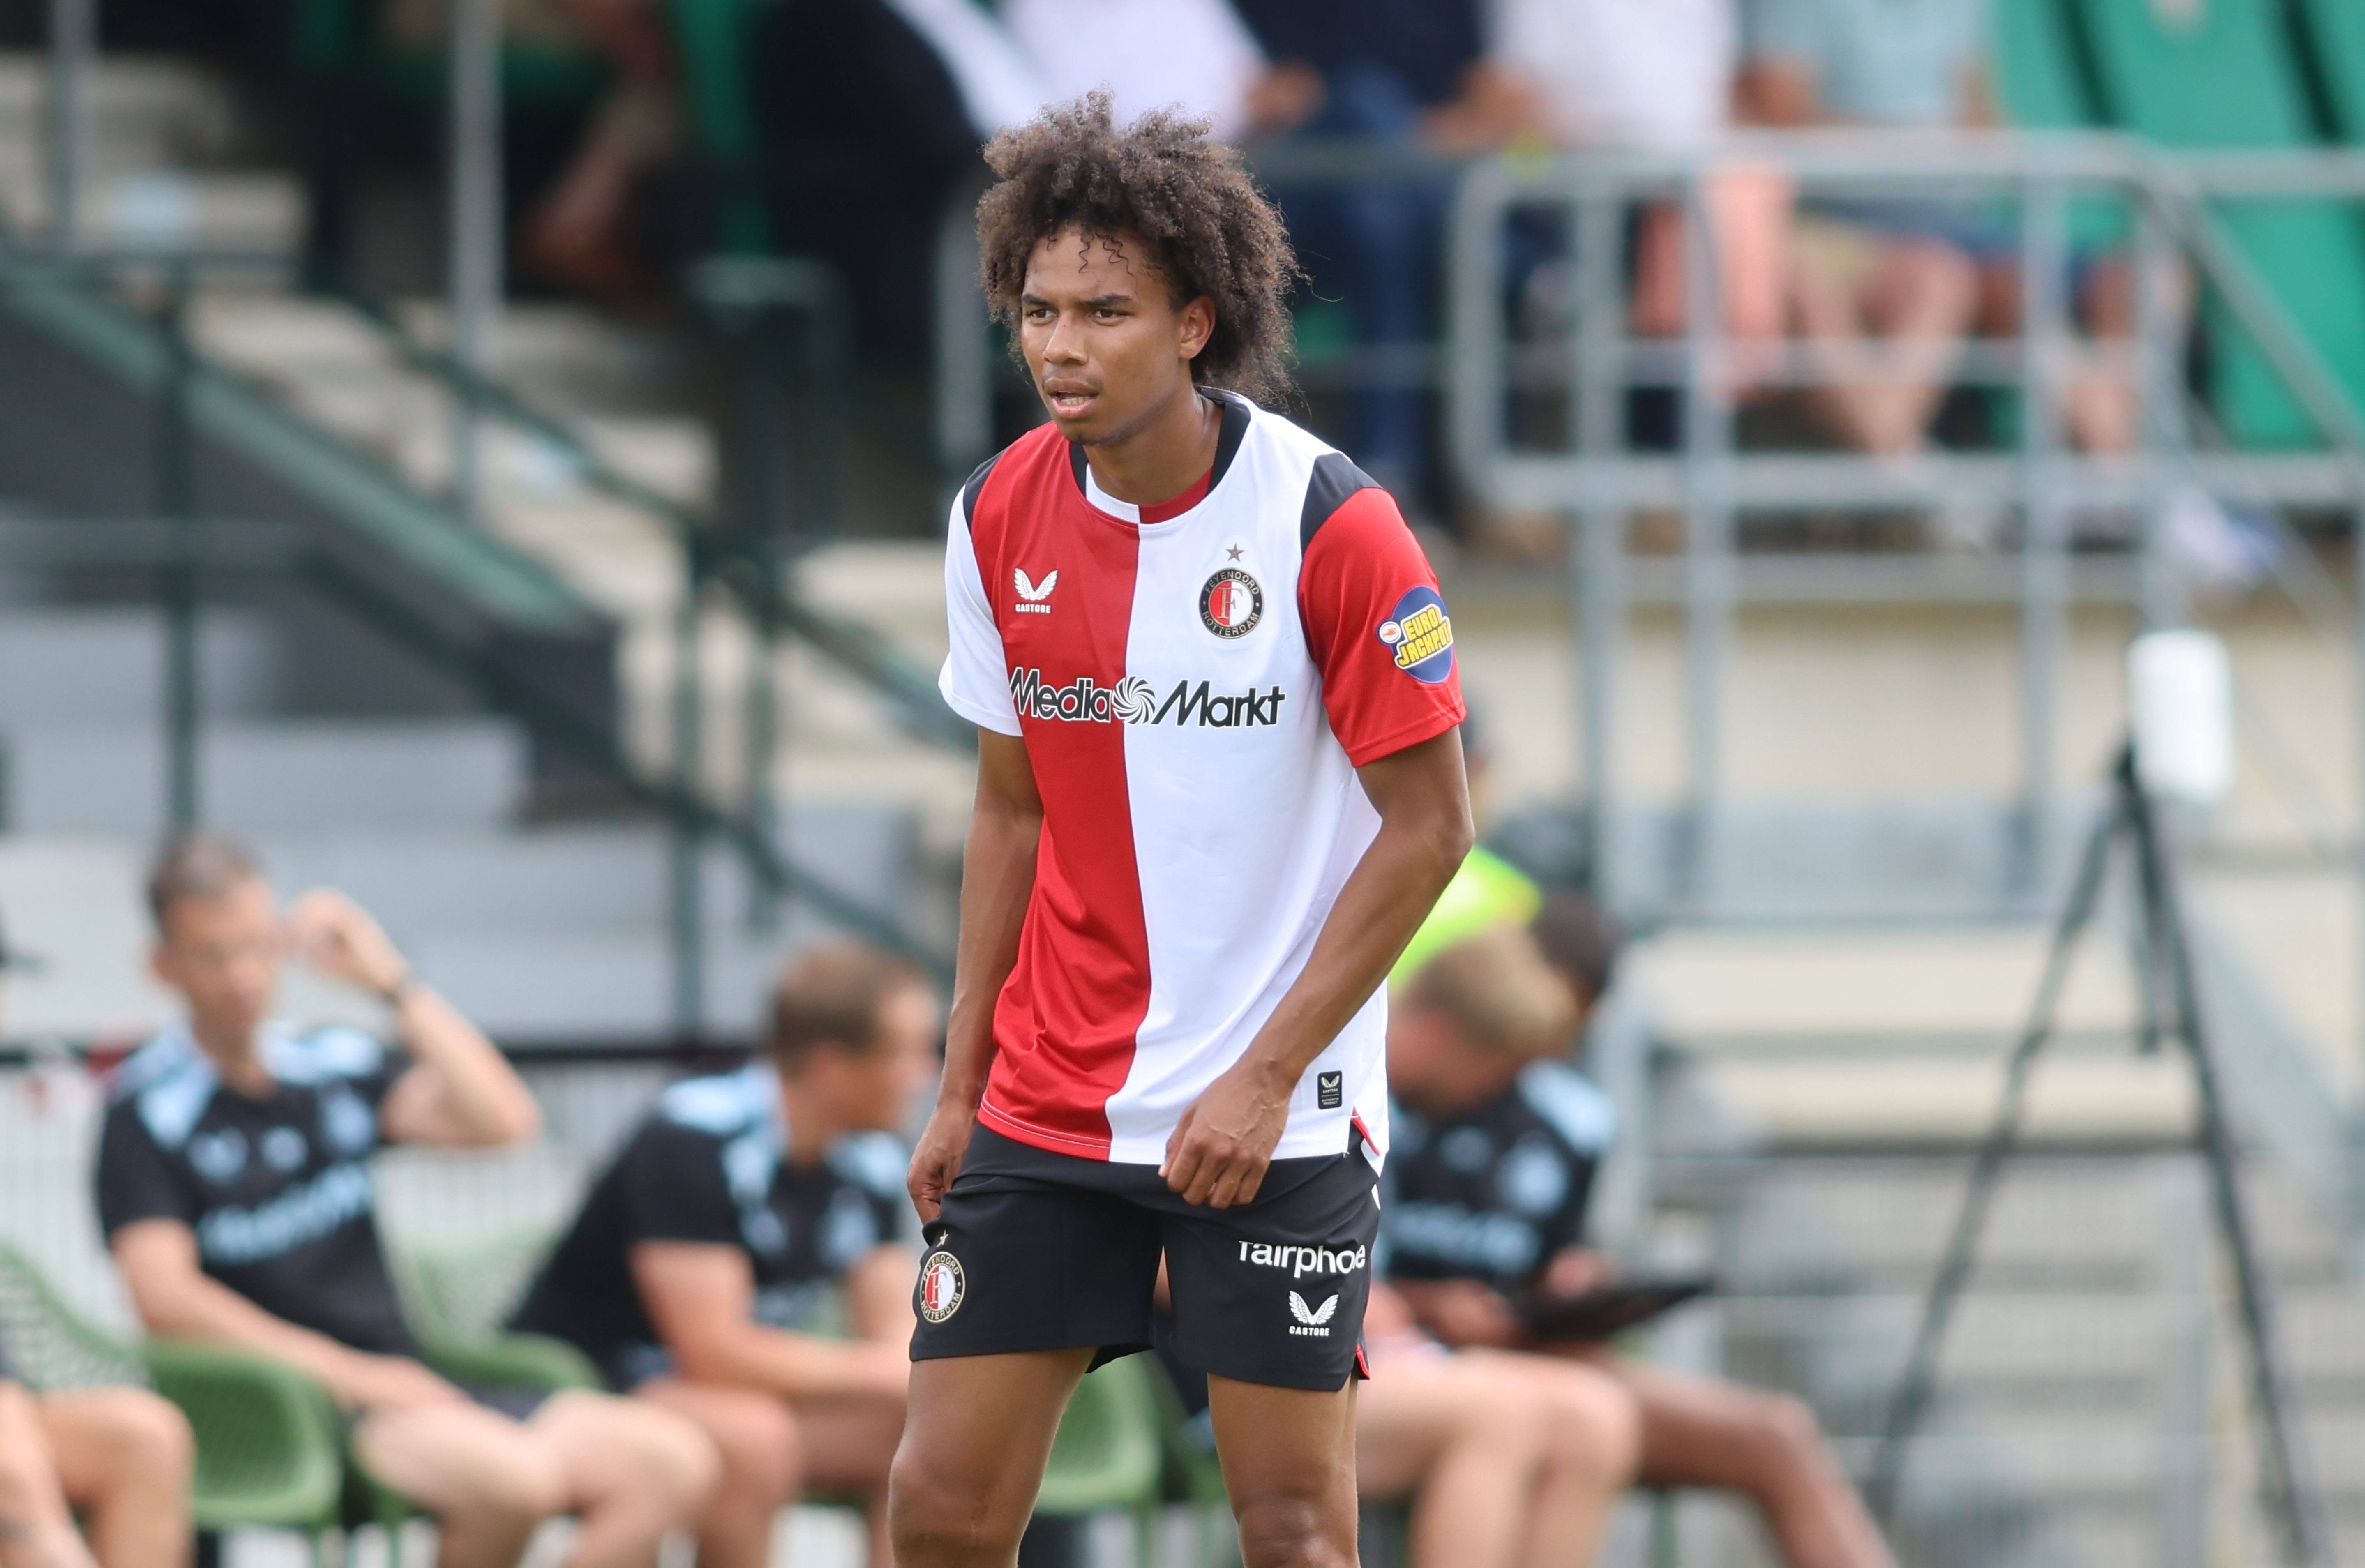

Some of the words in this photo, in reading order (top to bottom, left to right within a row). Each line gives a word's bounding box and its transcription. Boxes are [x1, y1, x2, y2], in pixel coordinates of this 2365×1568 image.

[1204, 571, 1259, 595] FEYENOORD
[1015, 603, 1051, 613] CASTORE
[1218, 587, 1243, 619] F
[1202, 612, 1259, 636] ROTTERDAM
[1403, 607, 1439, 641] EURO
[1398, 622, 1450, 666] JACKPOT
[1009, 666, 1112, 723] Media
[1150, 678, 1287, 727] Markt
[1239, 1240, 1365, 1279] fairphoe
[930, 1271, 947, 1305] F
[1289, 1326, 1330, 1337] CASTORE
